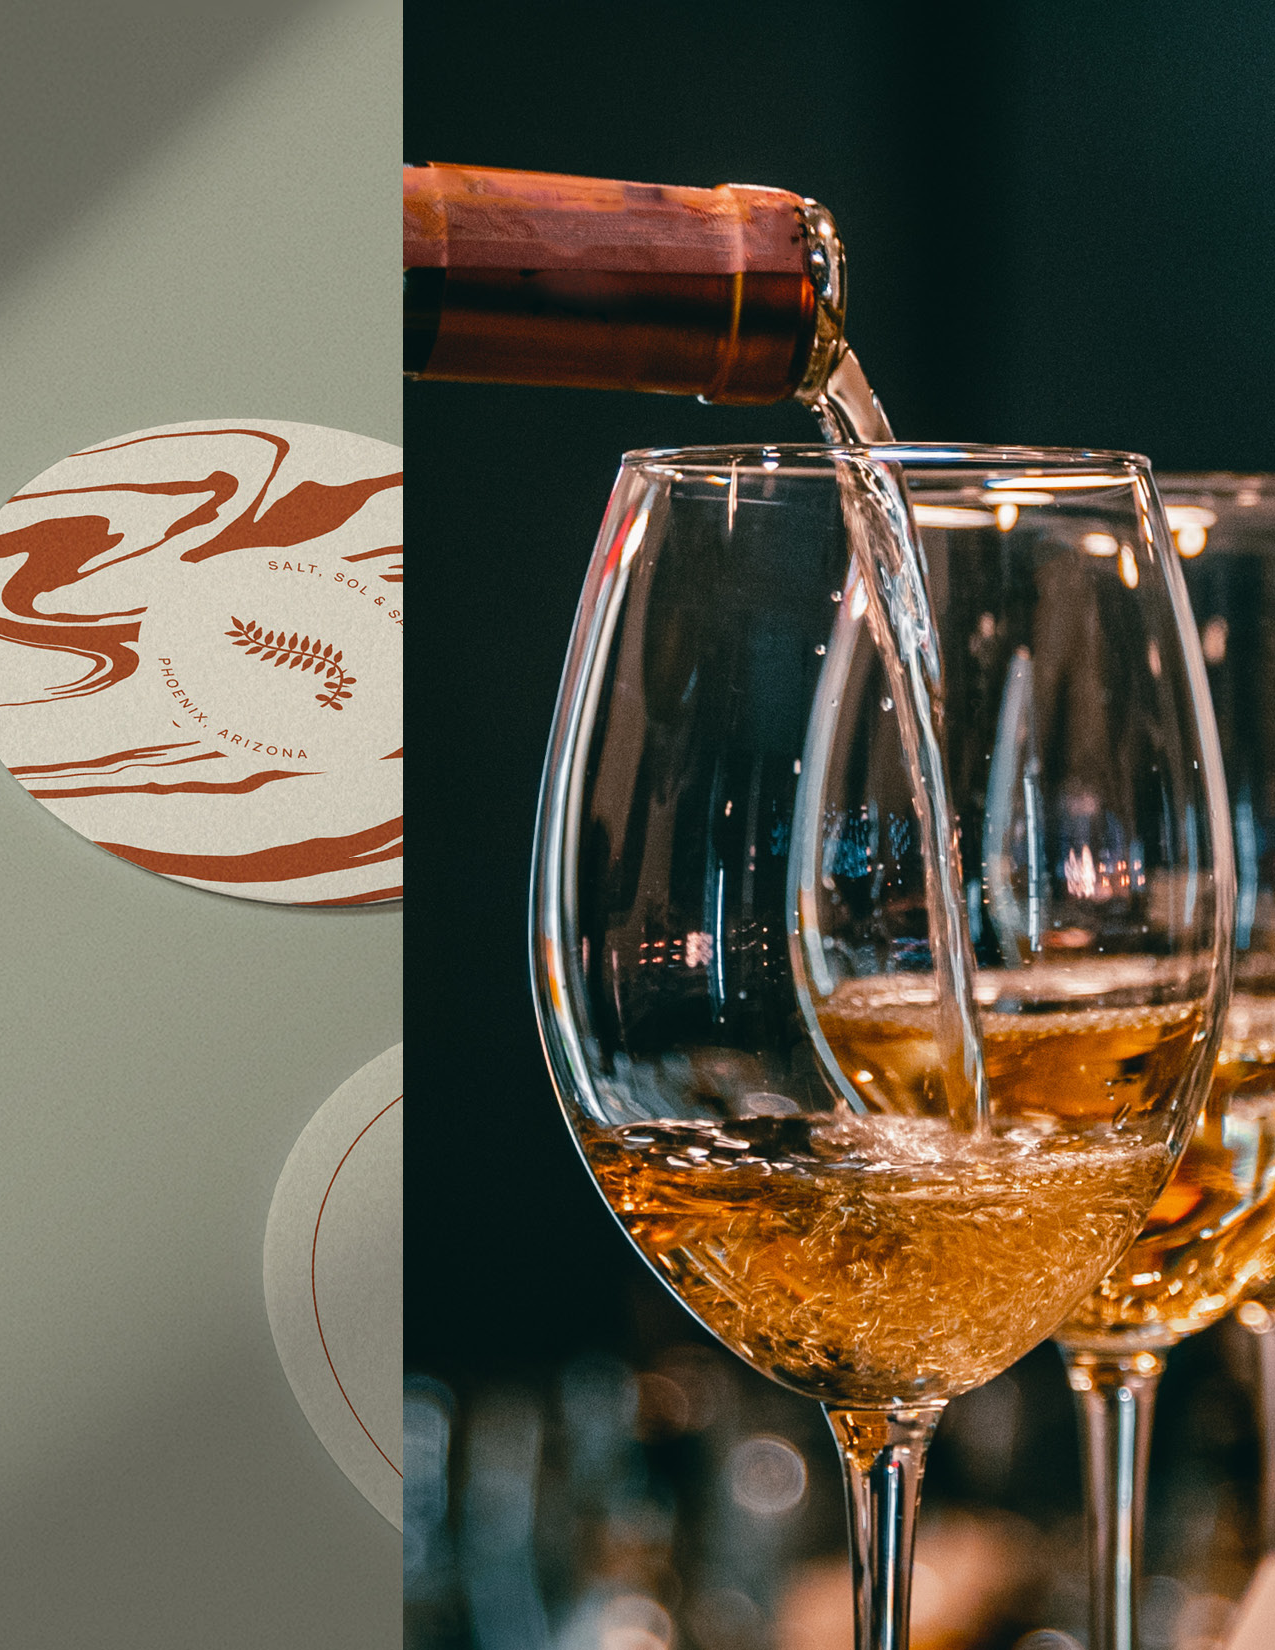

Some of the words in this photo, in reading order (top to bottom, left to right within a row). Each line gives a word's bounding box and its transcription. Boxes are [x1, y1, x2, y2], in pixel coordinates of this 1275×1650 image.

[268, 560, 323, 577] SALT,
[333, 572, 368, 596] SOL
[373, 596, 386, 606] &
[158, 657, 208, 729] PHOENIX,
[217, 728, 308, 759] ARIZONA
